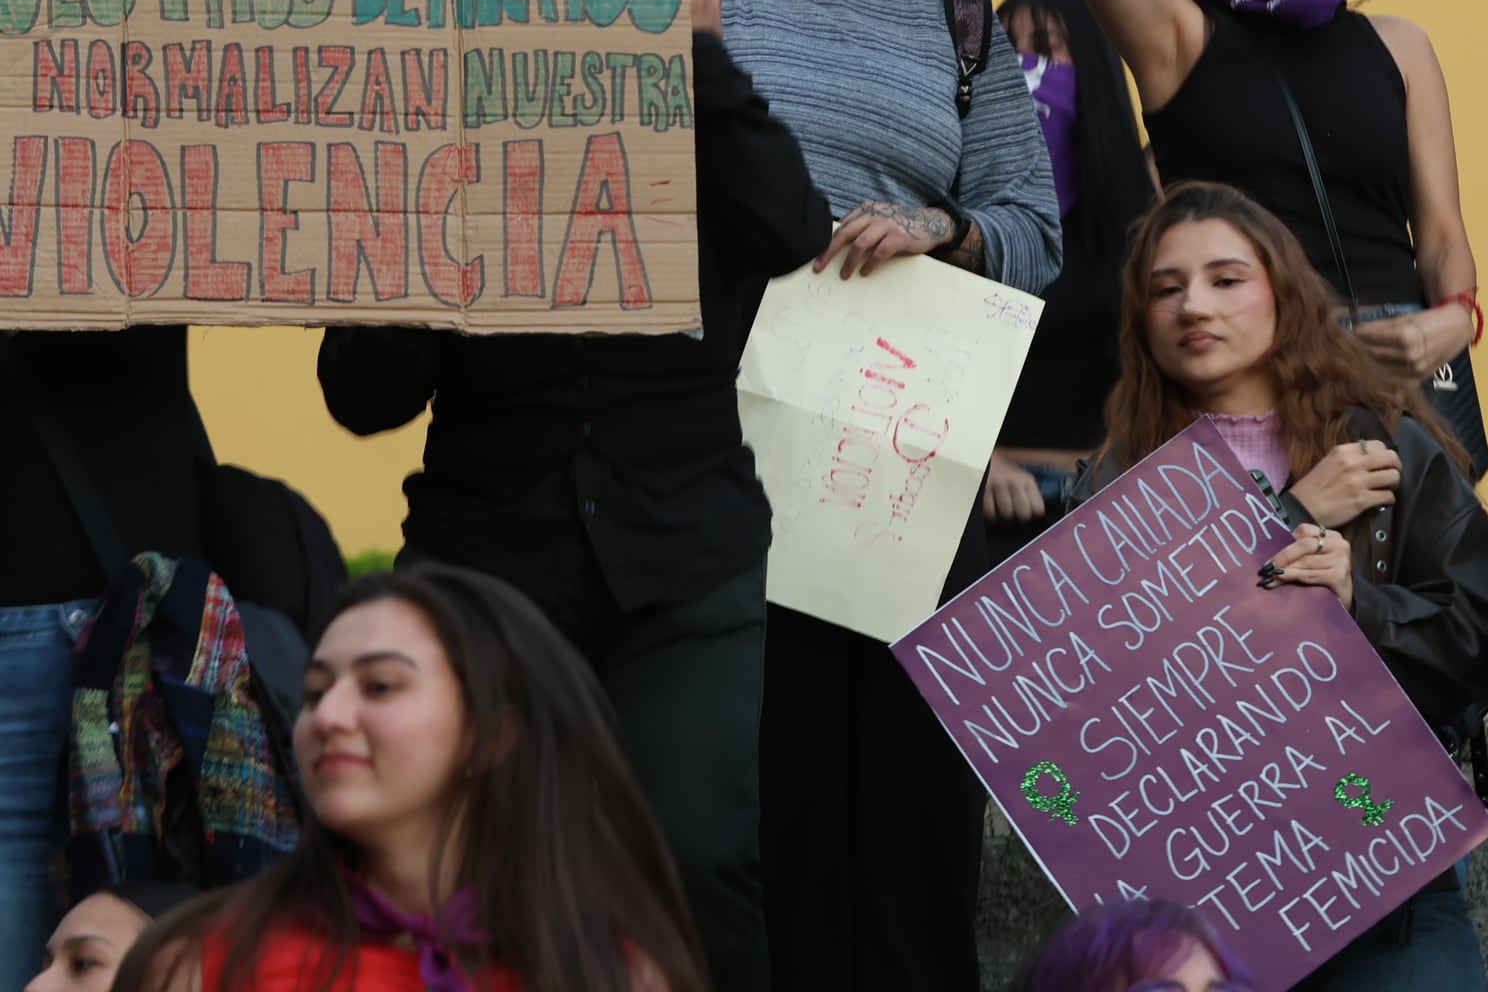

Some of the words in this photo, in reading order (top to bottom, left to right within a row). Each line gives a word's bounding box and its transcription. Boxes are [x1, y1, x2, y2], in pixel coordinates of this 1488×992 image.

[33, 39, 448, 134] NORMALIZAN
[464, 48, 694, 132] NUESTRA
[0, 132, 653, 310] VIOLENCIA
[916, 549, 1089, 705] NUNCA
[1072, 442, 1244, 586] CALLADA
[963, 632, 1112, 764] NUNCA
[1097, 493, 1293, 650] SOMETIDA
[1080, 605, 1274, 781] SIEMPRE
[1087, 640, 1337, 860] DECLARANDO
[1094, 879, 1150, 904] A
[1165, 744, 1327, 881] GUERRA
[1324, 700, 1391, 755] AL
[1187, 819, 1330, 930] TEMA
[1279, 795, 1466, 951] FEMICIDA
